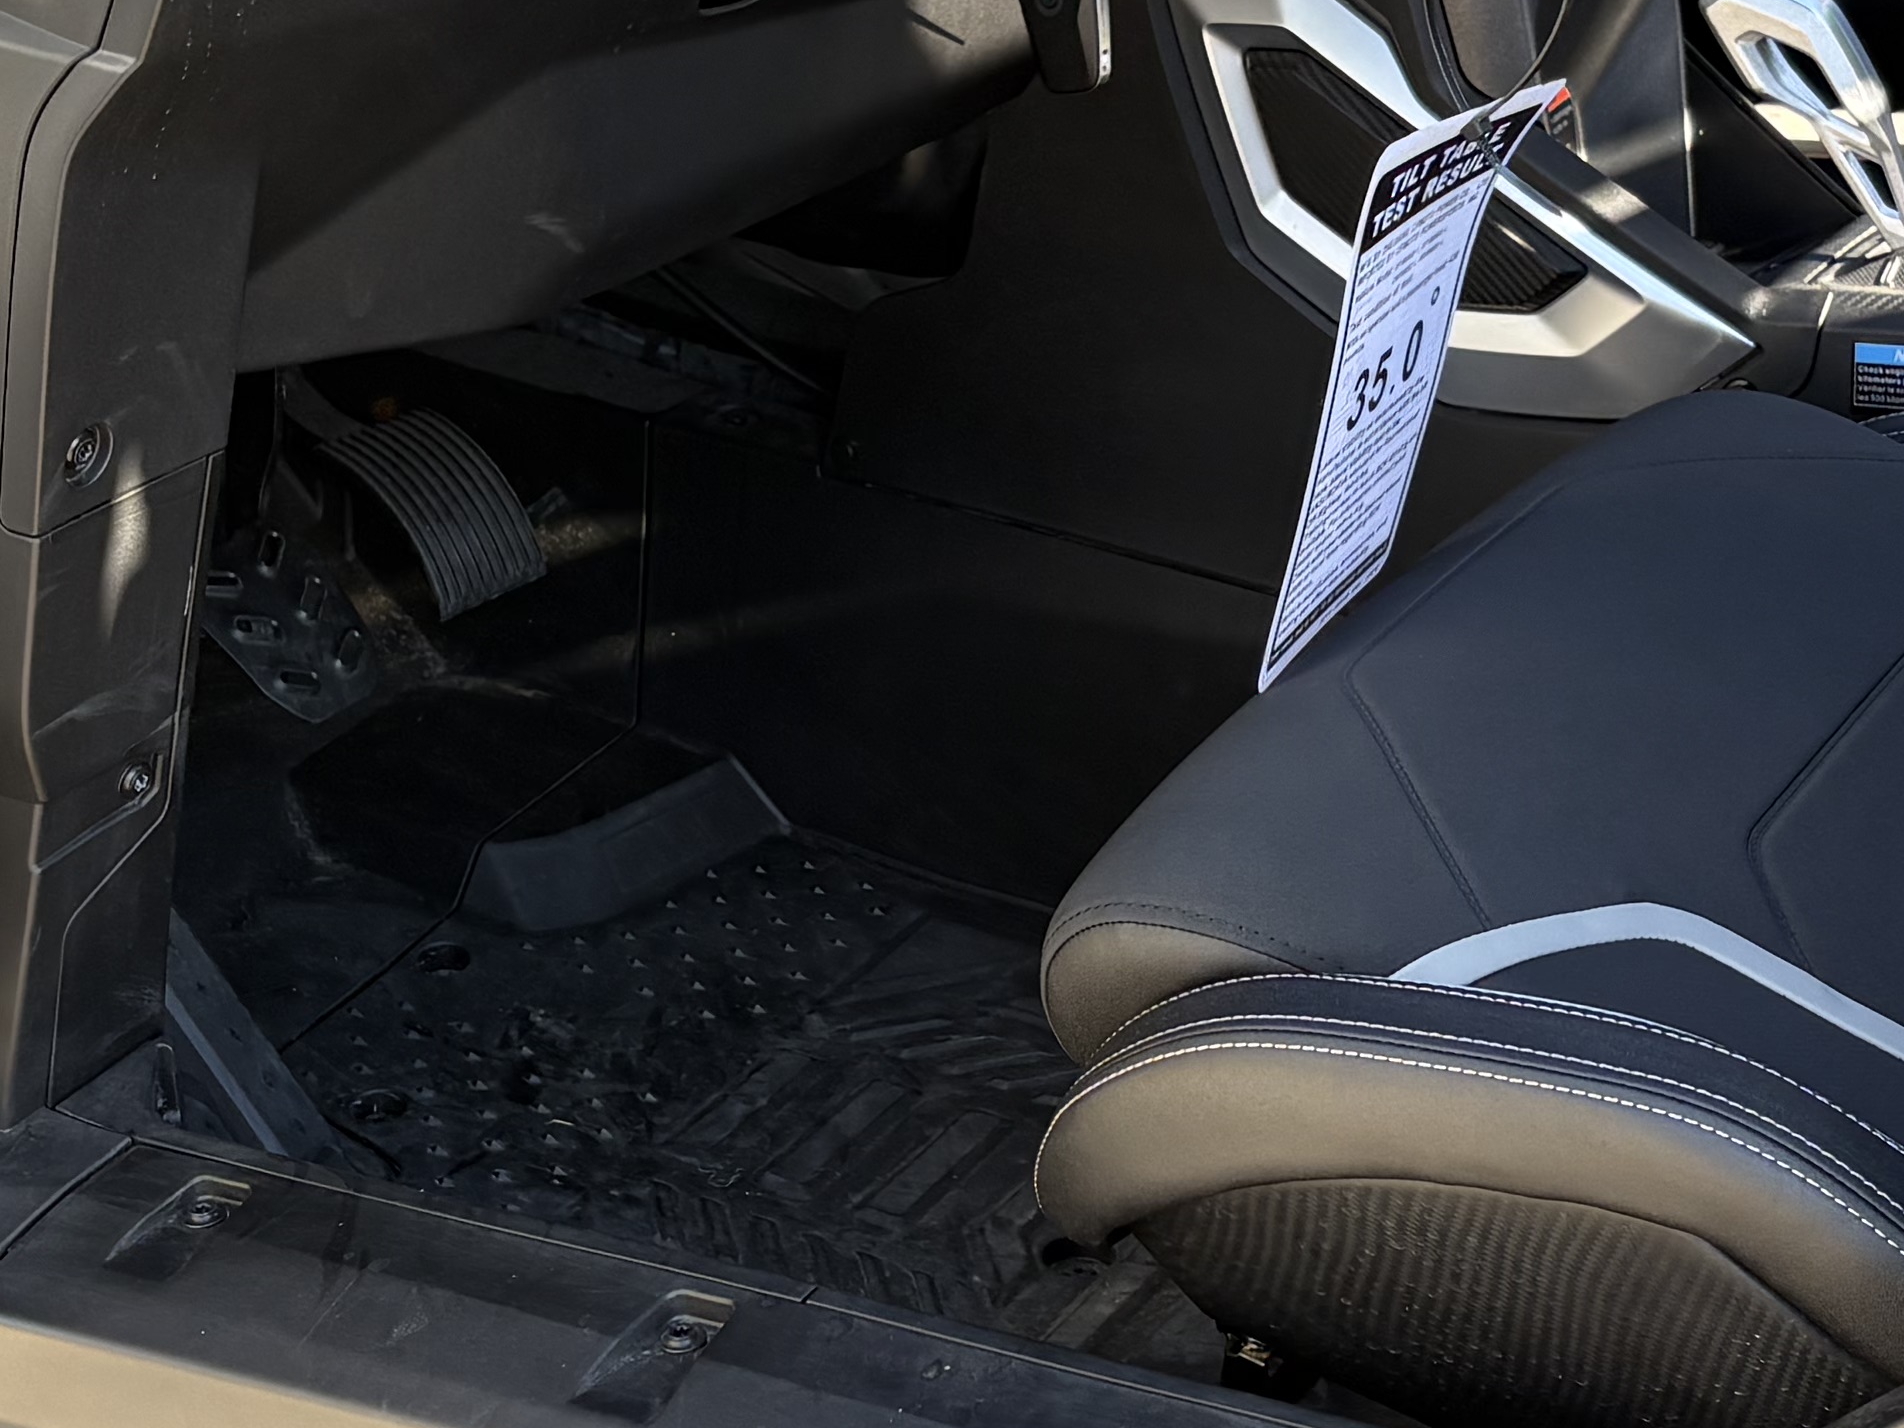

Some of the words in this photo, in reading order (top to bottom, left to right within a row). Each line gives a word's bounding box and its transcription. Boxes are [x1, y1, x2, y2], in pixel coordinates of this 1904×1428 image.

[1390, 153, 1438, 199] TILT
[1439, 122, 1512, 168] TABE
[1372, 187, 1421, 238] TEST
